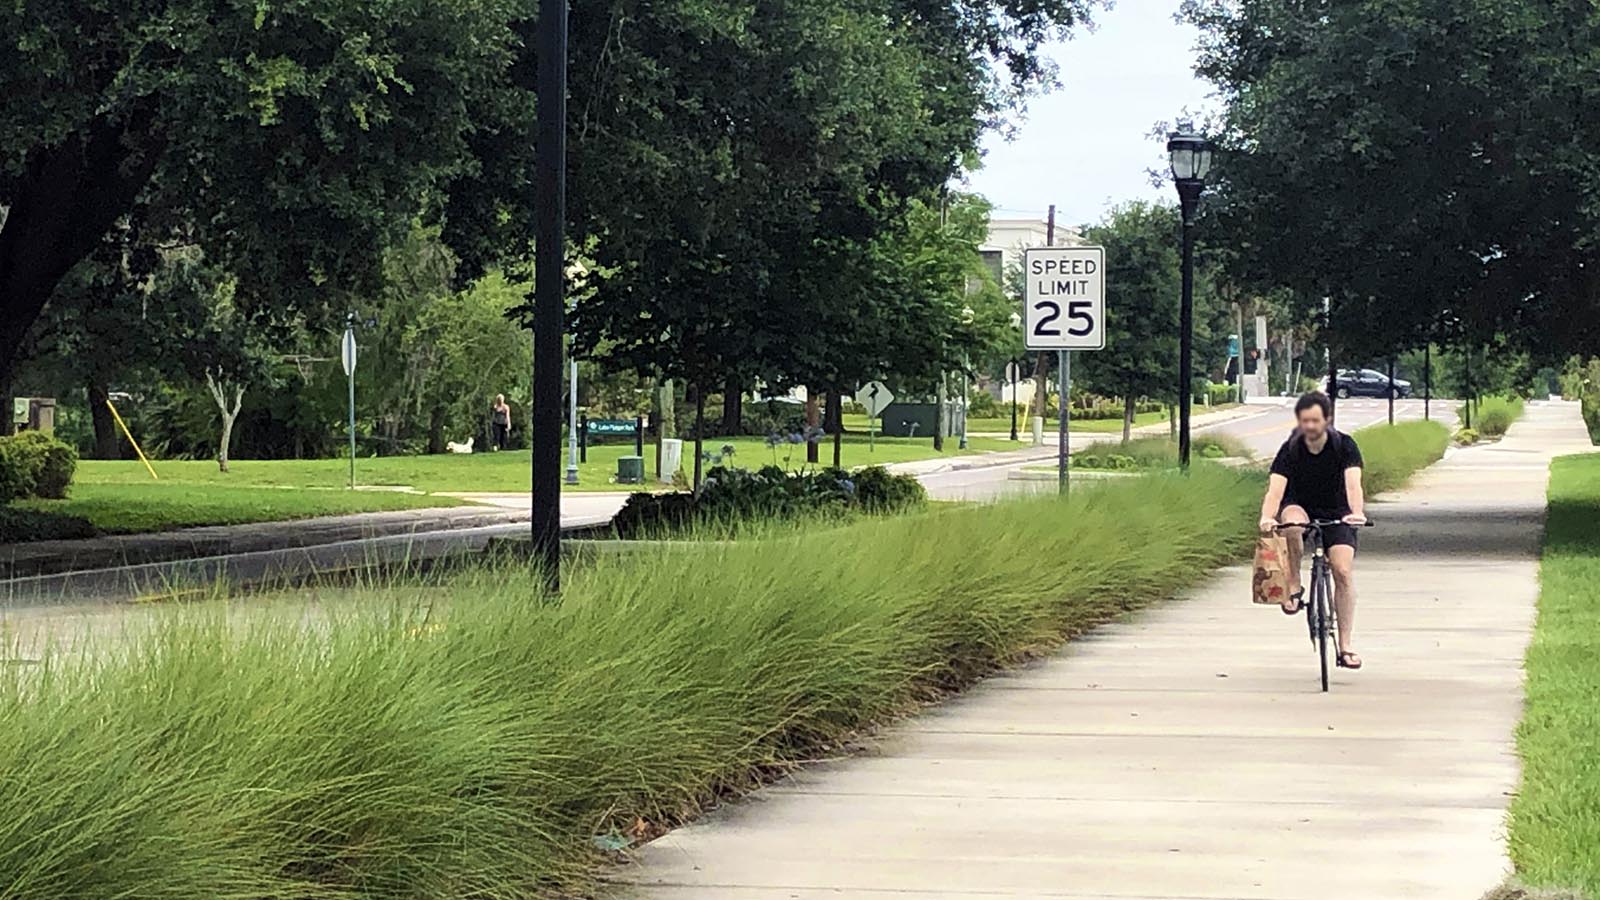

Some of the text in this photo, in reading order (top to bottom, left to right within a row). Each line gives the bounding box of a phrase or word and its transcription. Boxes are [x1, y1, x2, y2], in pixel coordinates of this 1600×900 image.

[1032, 260, 1096, 275] SPEED
[1038, 280, 1088, 295] LIMIT
[1033, 301, 1094, 336] 25
